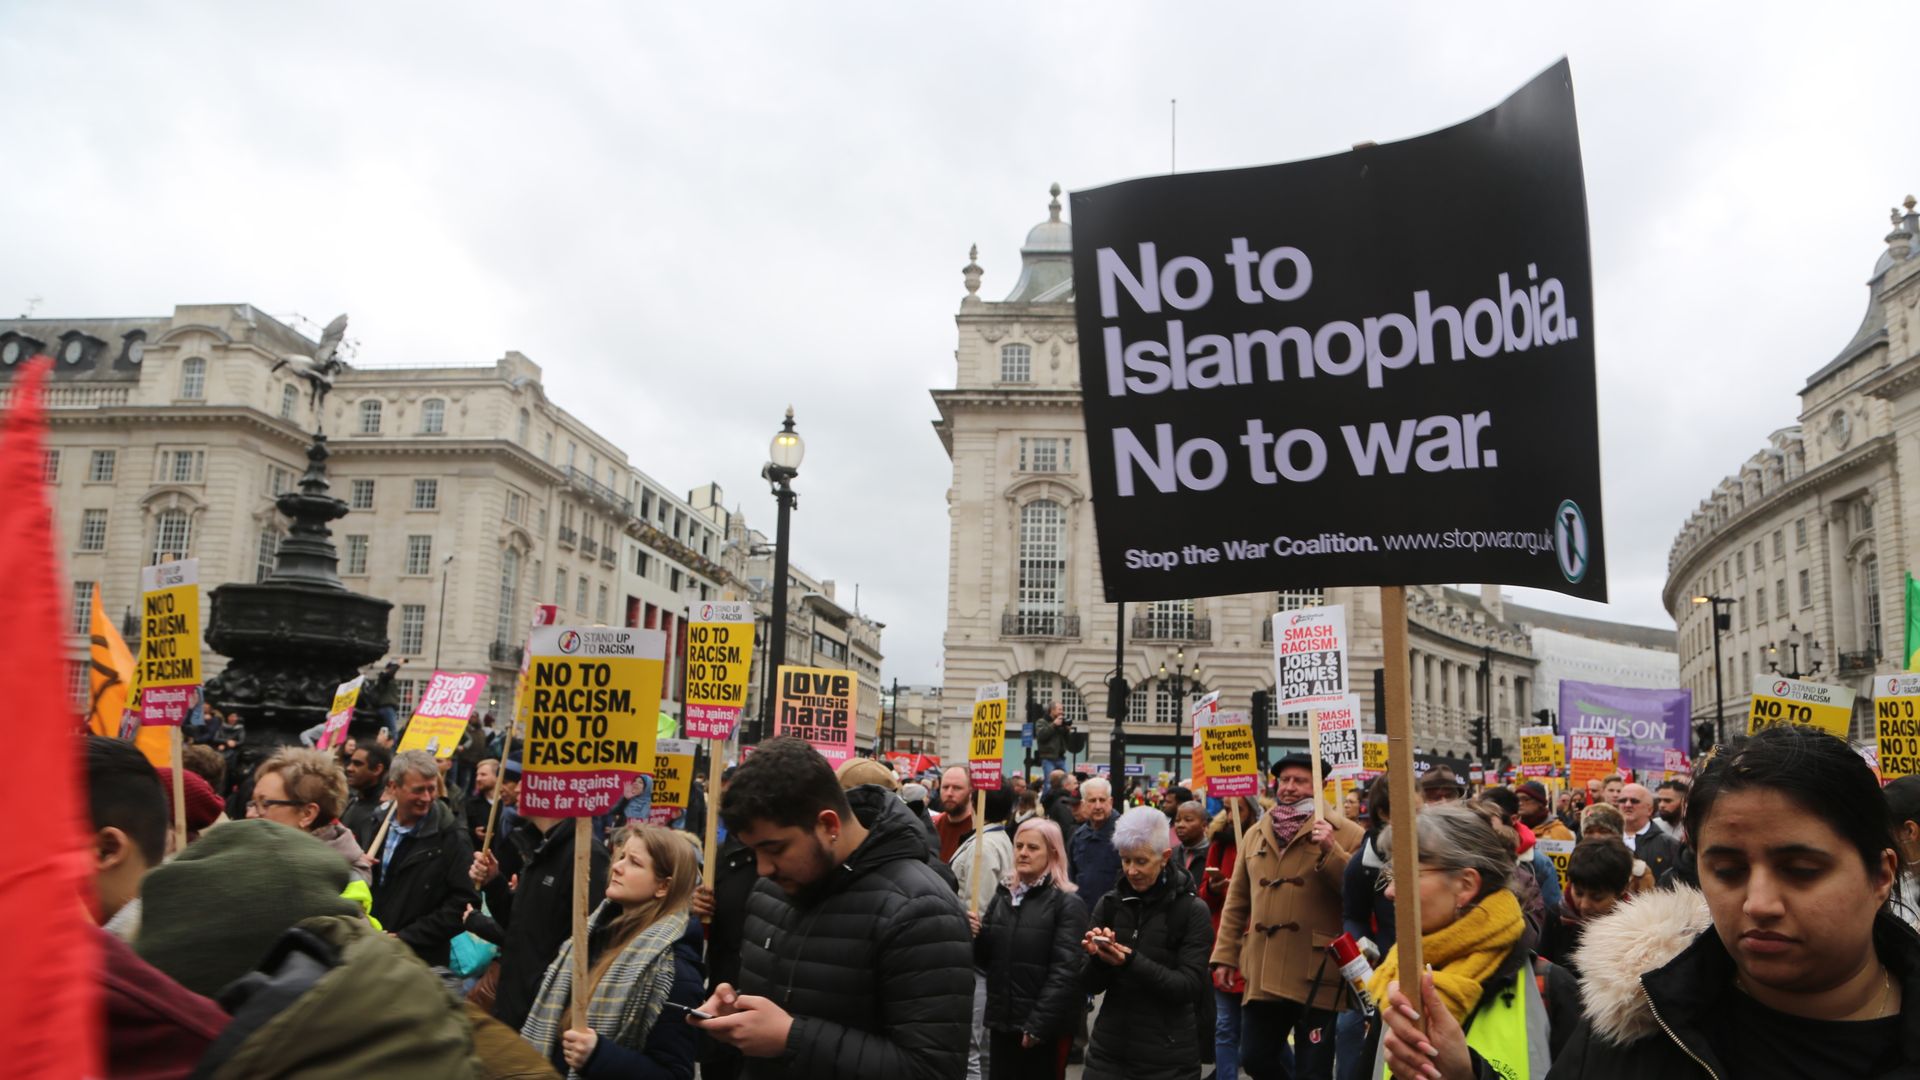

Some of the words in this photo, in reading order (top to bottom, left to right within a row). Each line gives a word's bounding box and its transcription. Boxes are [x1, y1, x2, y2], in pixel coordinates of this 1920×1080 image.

[1096, 242, 1214, 318] No
[1224, 236, 1313, 304] to
[1103, 263, 1578, 396] Islamophobia.
[1112, 423, 1228, 497] No
[1240, 419, 1328, 485] to
[1340, 410, 1498, 476] war.
[1125, 548, 1179, 571] Stop
[1181, 545, 1221, 565] the
[1222, 540, 1270, 561] War
[1273, 532, 1379, 557] Coalition.
[1381, 528, 1555, 556] www.stopwar.org.uk
[583, 632, 614, 643] STAND
[616, 633, 630, 643] UP
[690, 627, 708, 644] NO
[712, 627, 729, 644] TO
[1284, 625, 1333, 641] SMASH
[584, 644, 597, 654] TO
[598, 644, 634, 655] RACISM
[1281, 637, 1338, 655] RACISM!
[690, 646, 742, 664] RACISM,
[1283, 652, 1322, 671] JOBS
[1325, 652, 1338, 666] &
[535, 662, 572, 687] NO
[579, 663, 611, 687] TO
[689, 664, 706, 681] NO
[710, 664, 727, 682] TO
[1284, 666, 1338, 685] HOMES
[432, 675, 476, 691] STAND
[1282, 682, 1310, 700] FOR
[1312, 680, 1343, 695] ALL
[1792, 684, 1816, 694] STAND
[426, 687, 450, 702] UP
[688, 683, 742, 702] FASCISM
[1792, 691, 1801, 699] TO
[1803, 693, 1831, 703] RACISM
[533, 689, 636, 716] RACISM,
[990, 703, 1001, 719] TO
[1754, 699, 1782, 717] NO
[1787, 704, 1812, 723] TO
[1879, 701, 1899, 718] NO
[686, 706, 705, 718] Unite
[706, 708, 735, 722] against
[1317, 709, 1350, 721] SMASH
[531, 715, 568, 739] NO
[576, 715, 608, 738] TO
[698, 721, 709, 732] far
[973, 720, 1002, 738] RACIST
[1318, 719, 1354, 732] ACISM!
[1580, 715, 1667, 740] UNISON
[1206, 728, 1247, 741] Migrants
[1320, 731, 1343, 743] OBS
[1346, 730, 1355, 740] &
[1572, 736, 1589, 748] NO
[1592, 737, 1607, 749] TO
[529, 741, 638, 765] FASCISM
[975, 739, 996, 755] UKIP
[1204, 741, 1210, 751] &
[1212, 740, 1252, 752] refugees
[1572, 747, 1612, 761] RACISM
[1881, 738, 1903, 755] NO
[655, 756, 669, 768] TO
[1210, 752, 1249, 762] welcome
[1338, 752, 1358, 765] ALL
[1220, 763, 1241, 773] here
[527, 775, 566, 791] Unite
[569, 774, 620, 793] against
[525, 793, 550, 809] the
[554, 794, 573, 809] far
[578, 792, 610, 811] right
